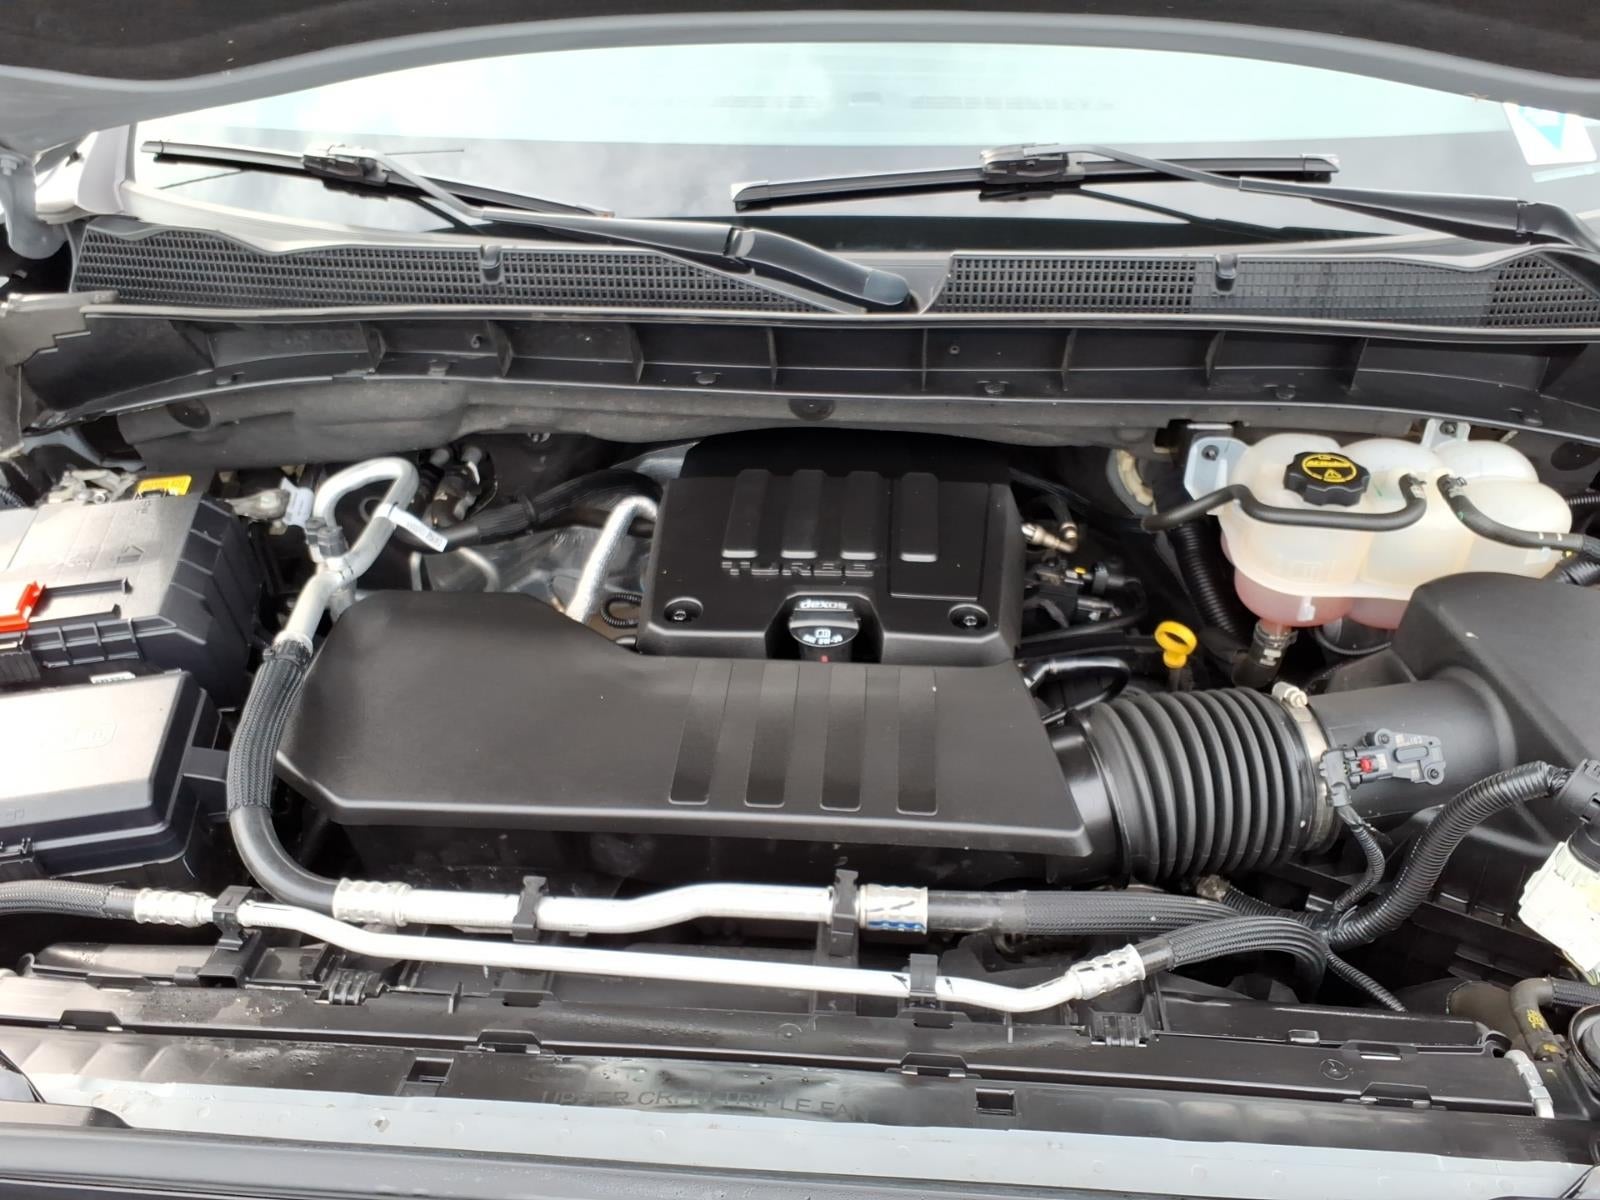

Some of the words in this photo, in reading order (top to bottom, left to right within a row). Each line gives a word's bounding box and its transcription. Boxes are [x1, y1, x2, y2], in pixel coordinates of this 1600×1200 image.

[800, 599, 848, 610] dexos
[724, 1091, 811, 1113] TRIPLE
[820, 1101, 869, 1121] FAN
